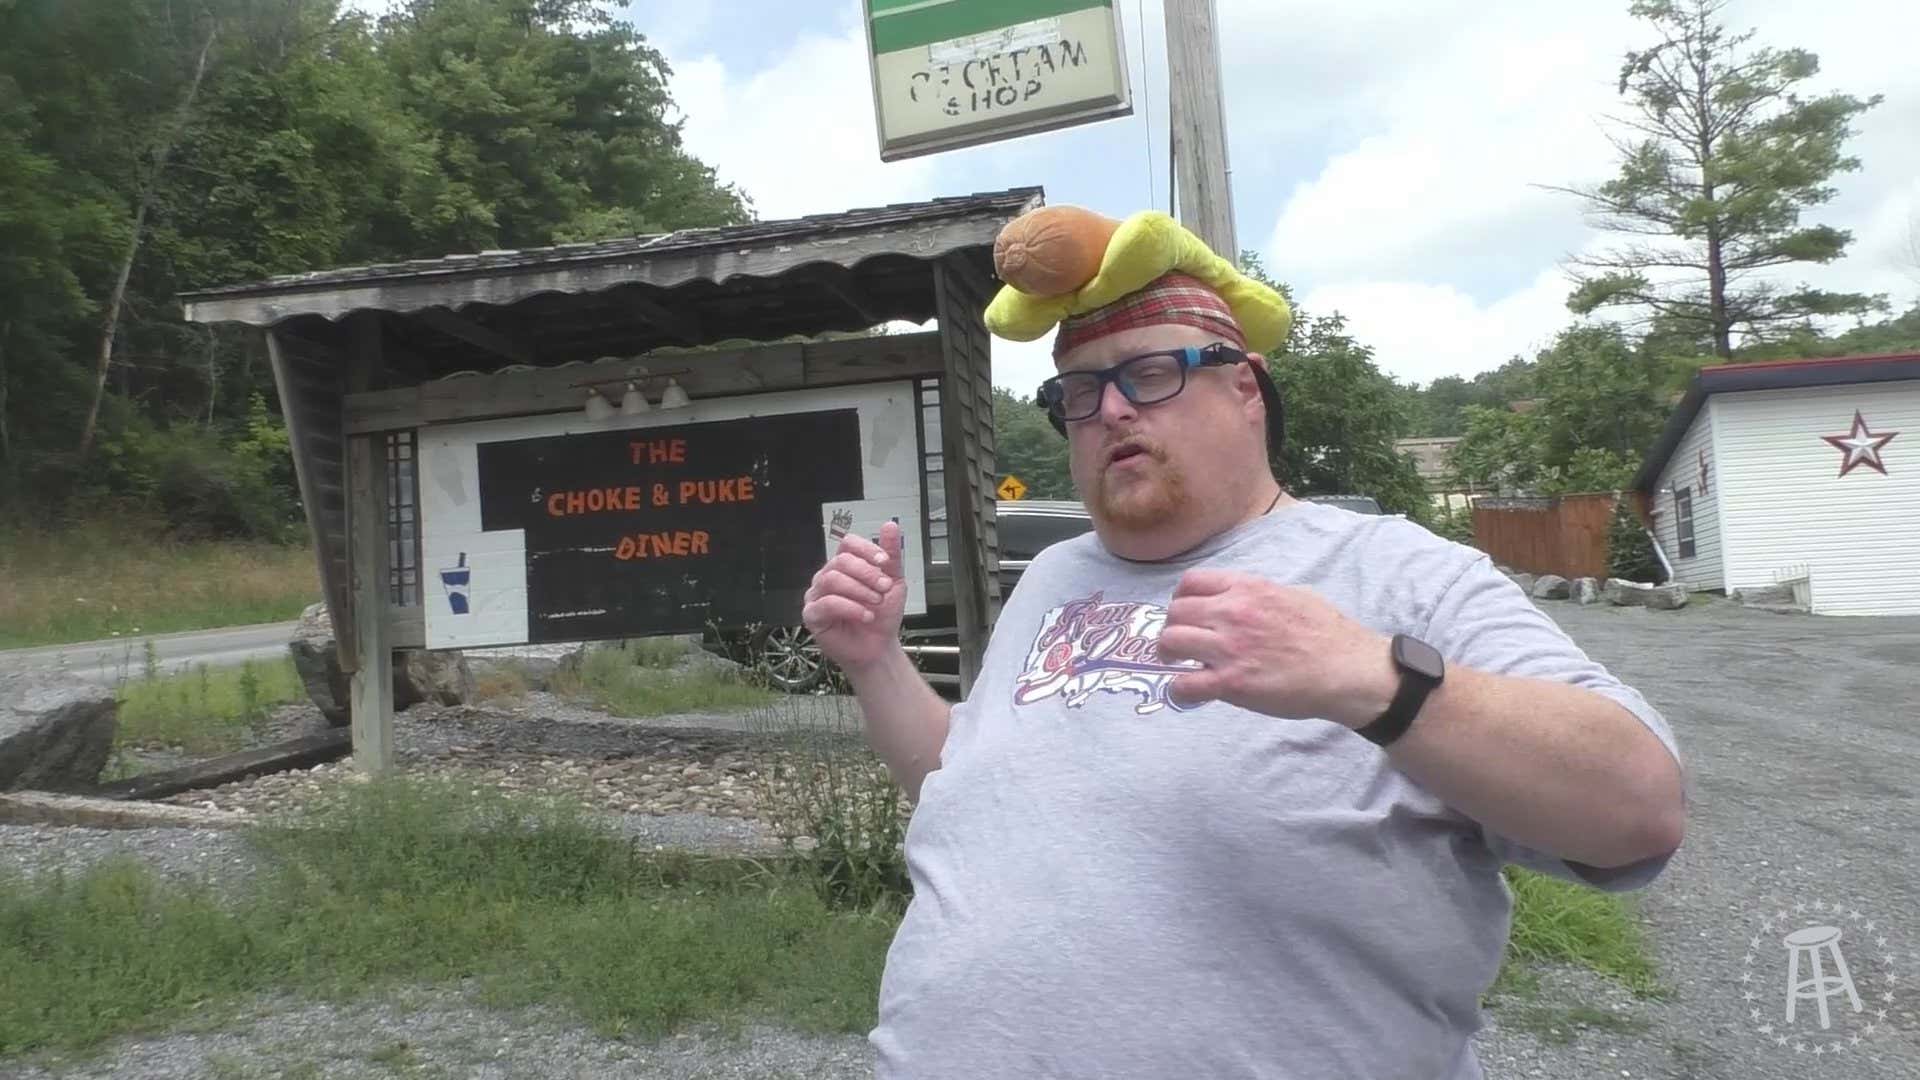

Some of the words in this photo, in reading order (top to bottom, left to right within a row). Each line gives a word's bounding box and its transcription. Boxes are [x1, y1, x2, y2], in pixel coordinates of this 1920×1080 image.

[942, 79, 1042, 116] SHOP
[629, 439, 687, 465] THE
[547, 486, 642, 517] CHOKE
[652, 483, 669, 506] &
[679, 475, 755, 504] PUKE
[615, 530, 710, 561] DINER
